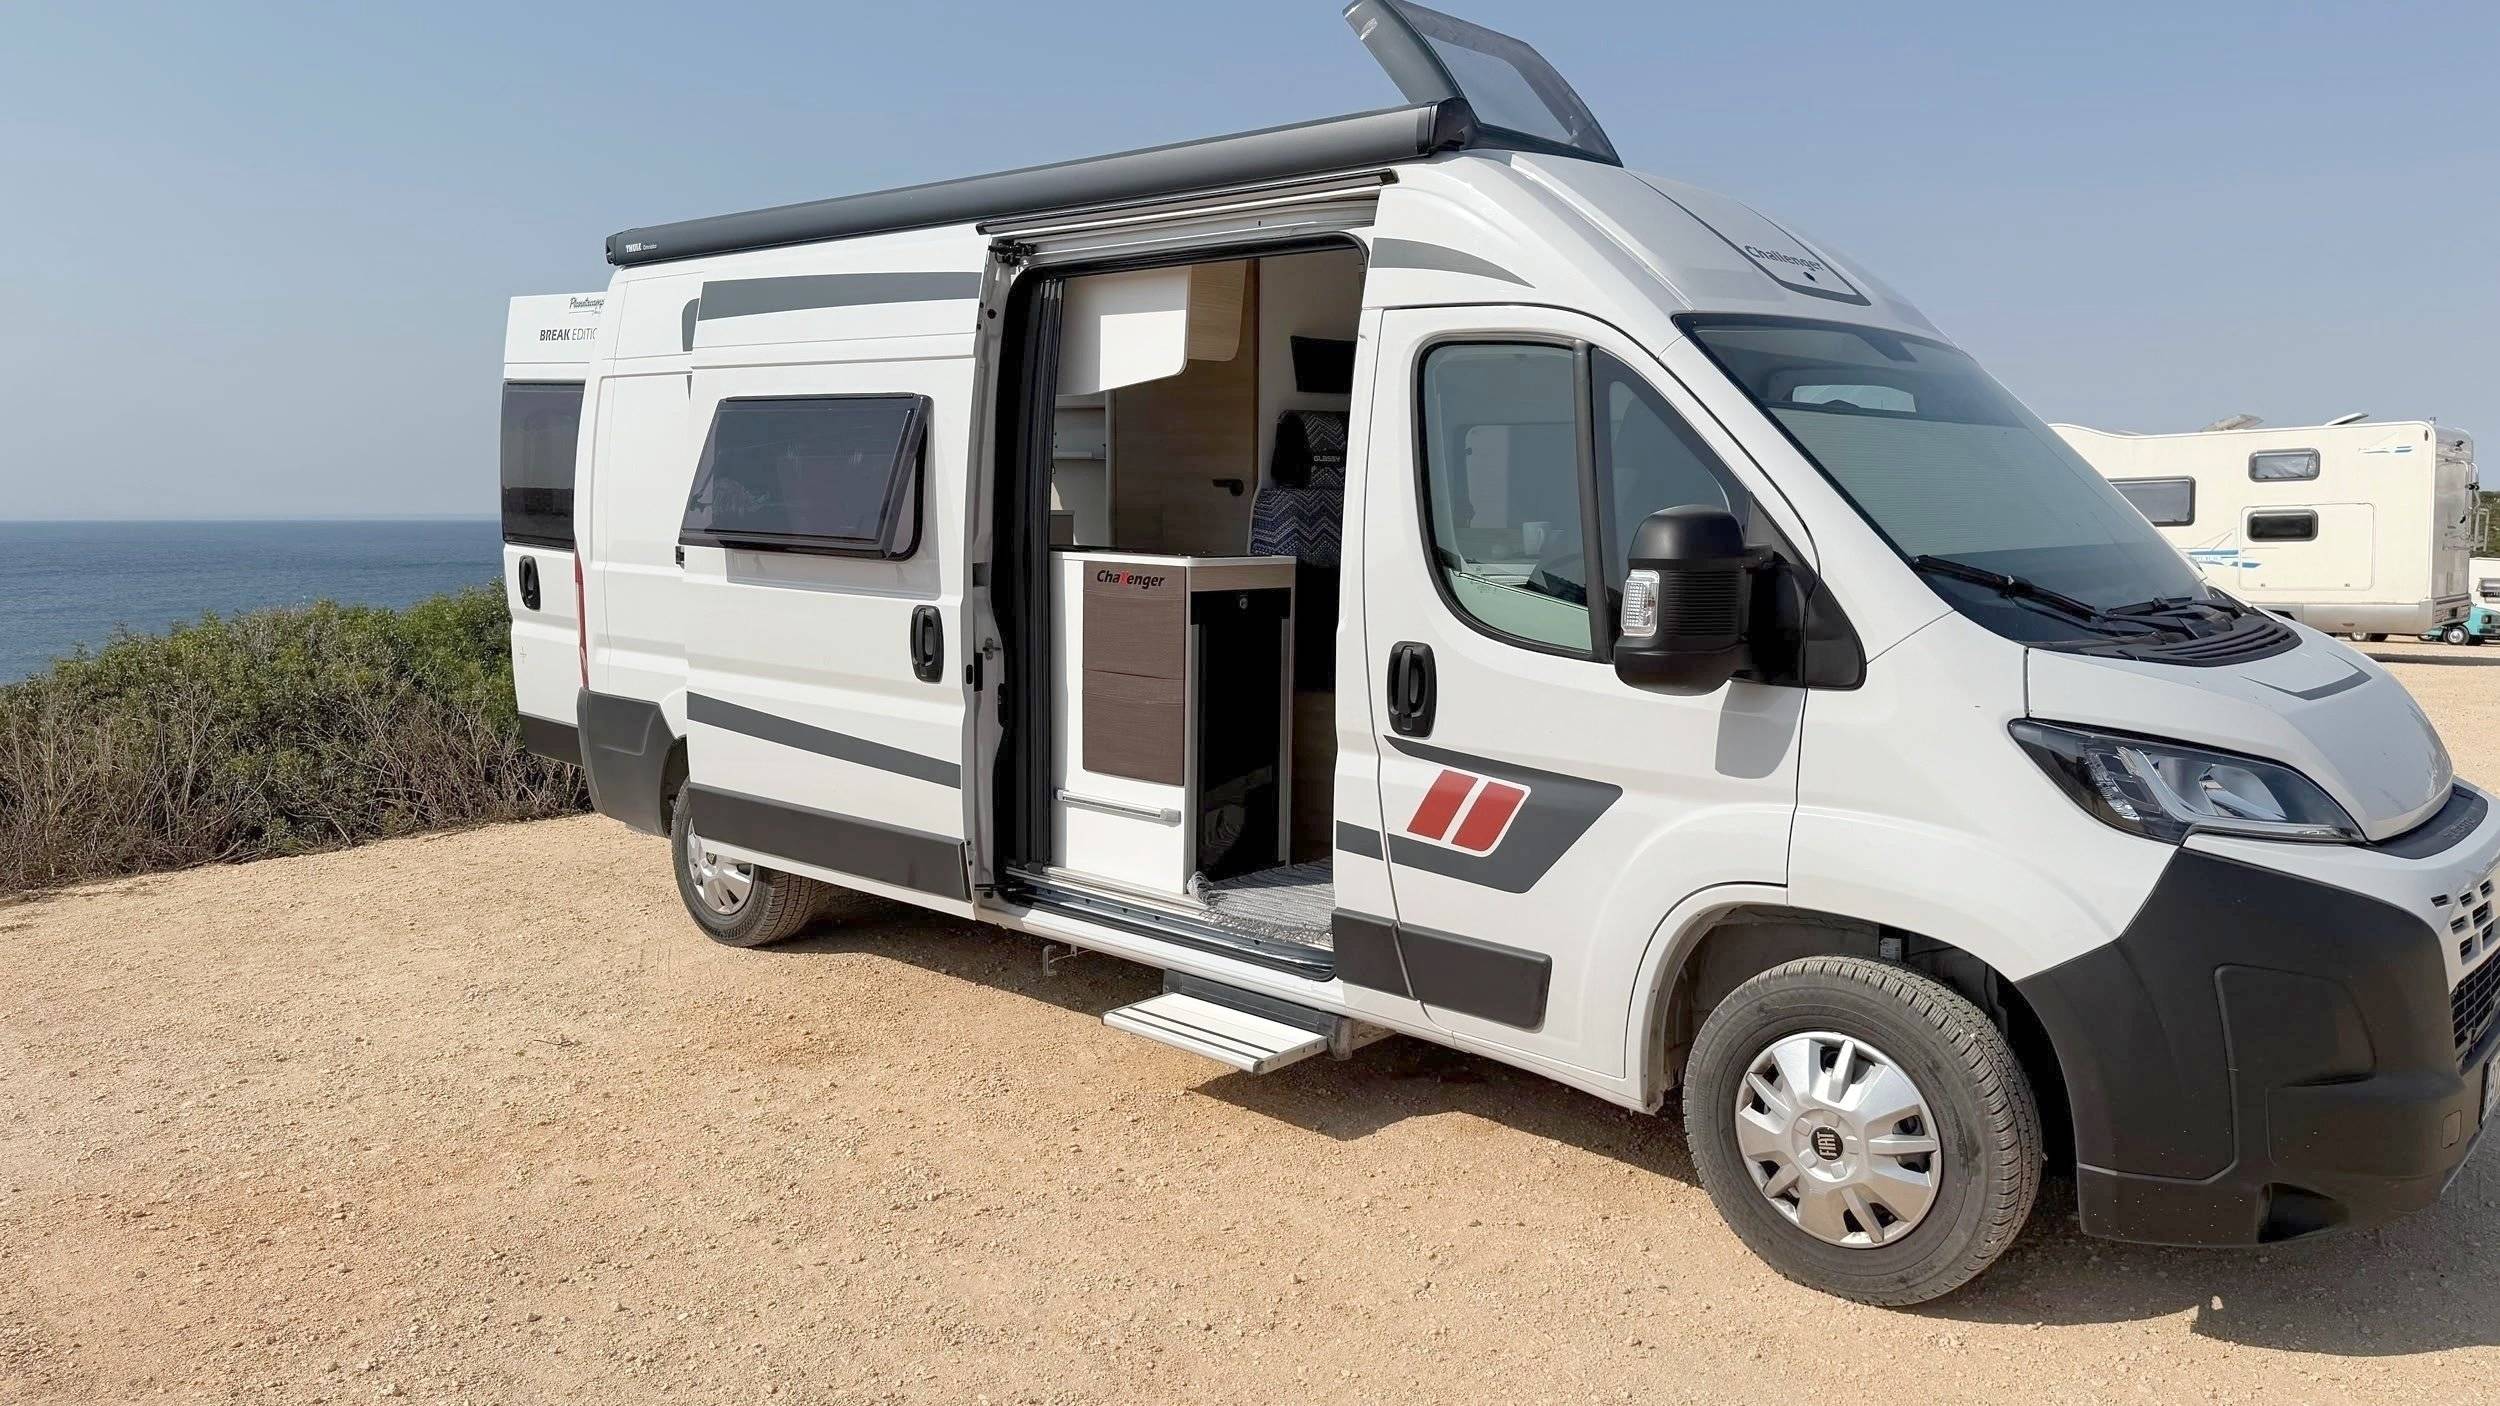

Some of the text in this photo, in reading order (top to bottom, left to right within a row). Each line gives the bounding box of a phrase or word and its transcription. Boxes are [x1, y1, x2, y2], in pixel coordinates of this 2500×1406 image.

[1744, 245, 1825, 272] Challenger
[539, 328, 571, 341] BREAK
[1817, 1131, 1838, 1157] FIAT
